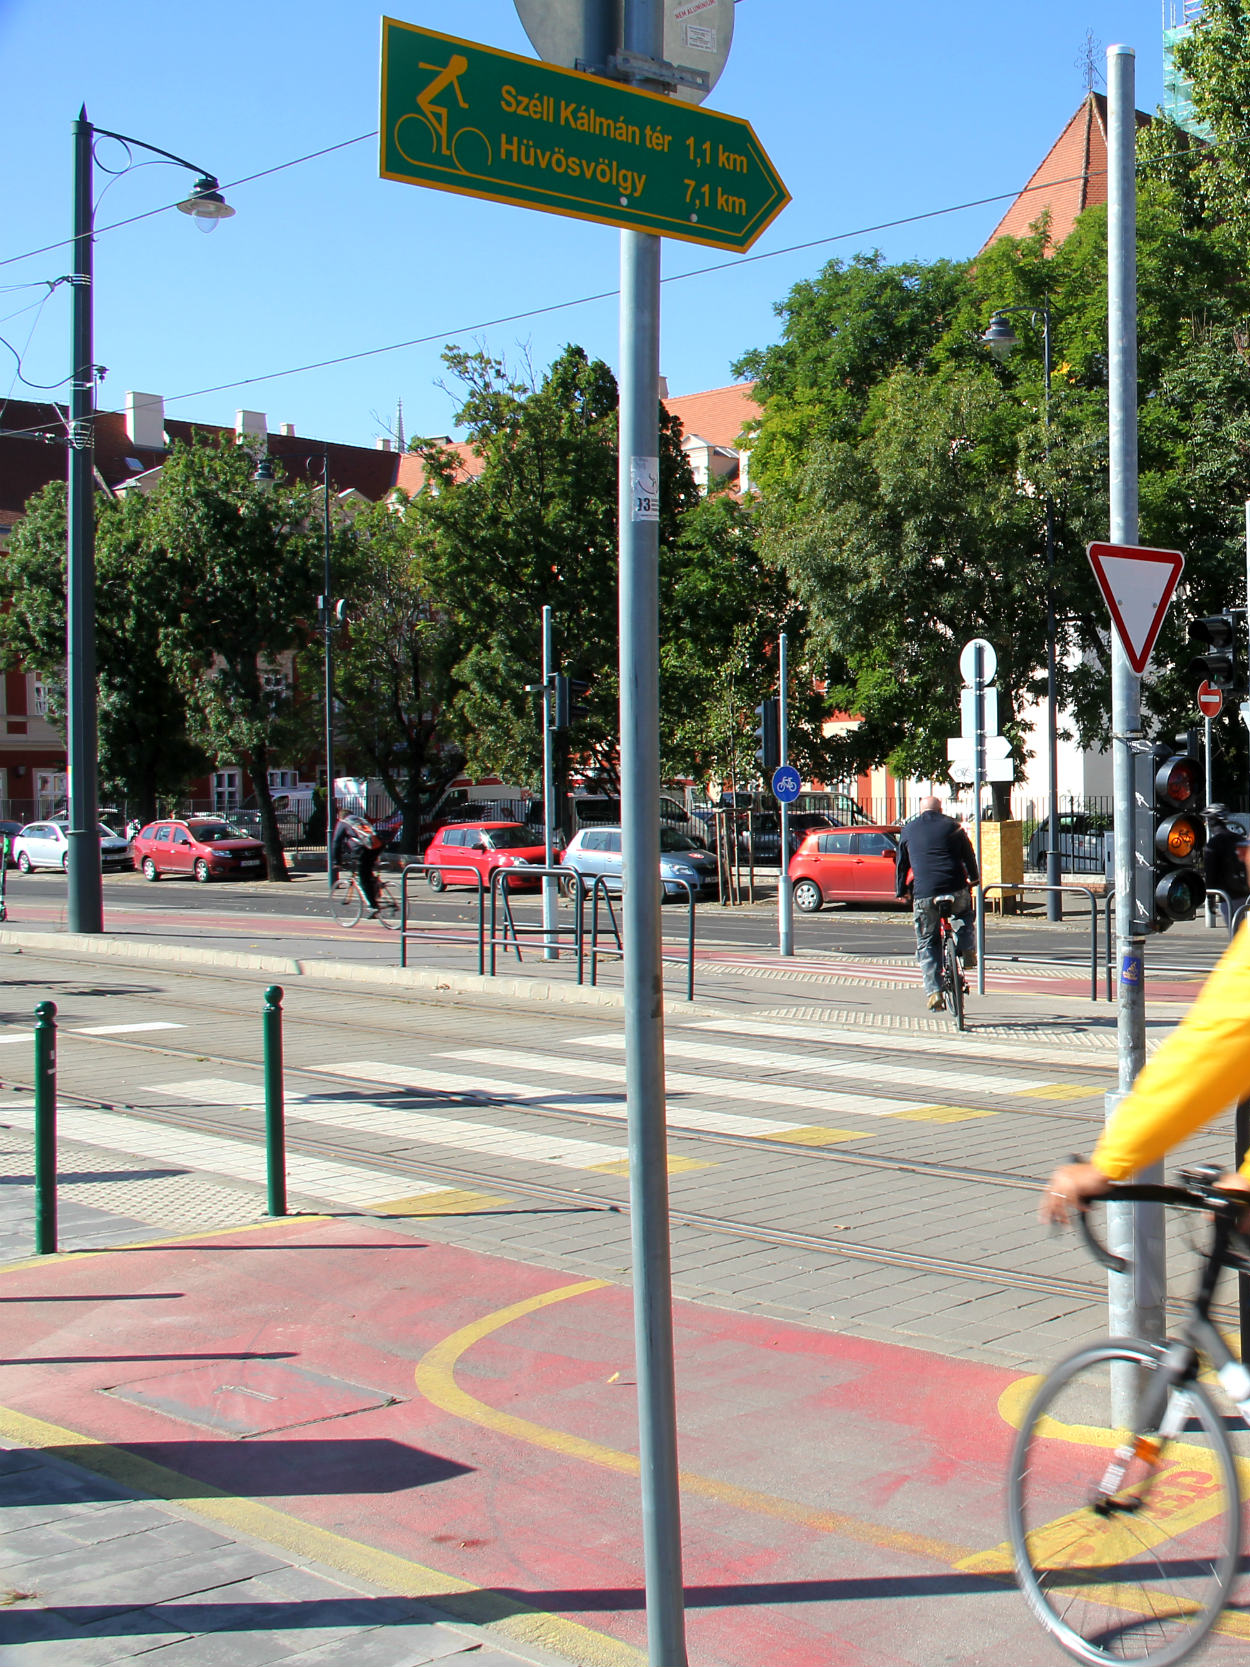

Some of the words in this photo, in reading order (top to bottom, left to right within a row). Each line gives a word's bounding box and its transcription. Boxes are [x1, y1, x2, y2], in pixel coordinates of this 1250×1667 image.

[501, 85, 554, 122] Széll
[560, 101, 640, 145] Kálmán
[645, 125, 672, 152] tér
[685, 136, 711, 168] 1,1
[718, 143, 747, 174] km
[500, 133, 647, 197] Hüvösvölgy
[683, 178, 709, 210] 7,1
[717, 186, 746, 216] km
